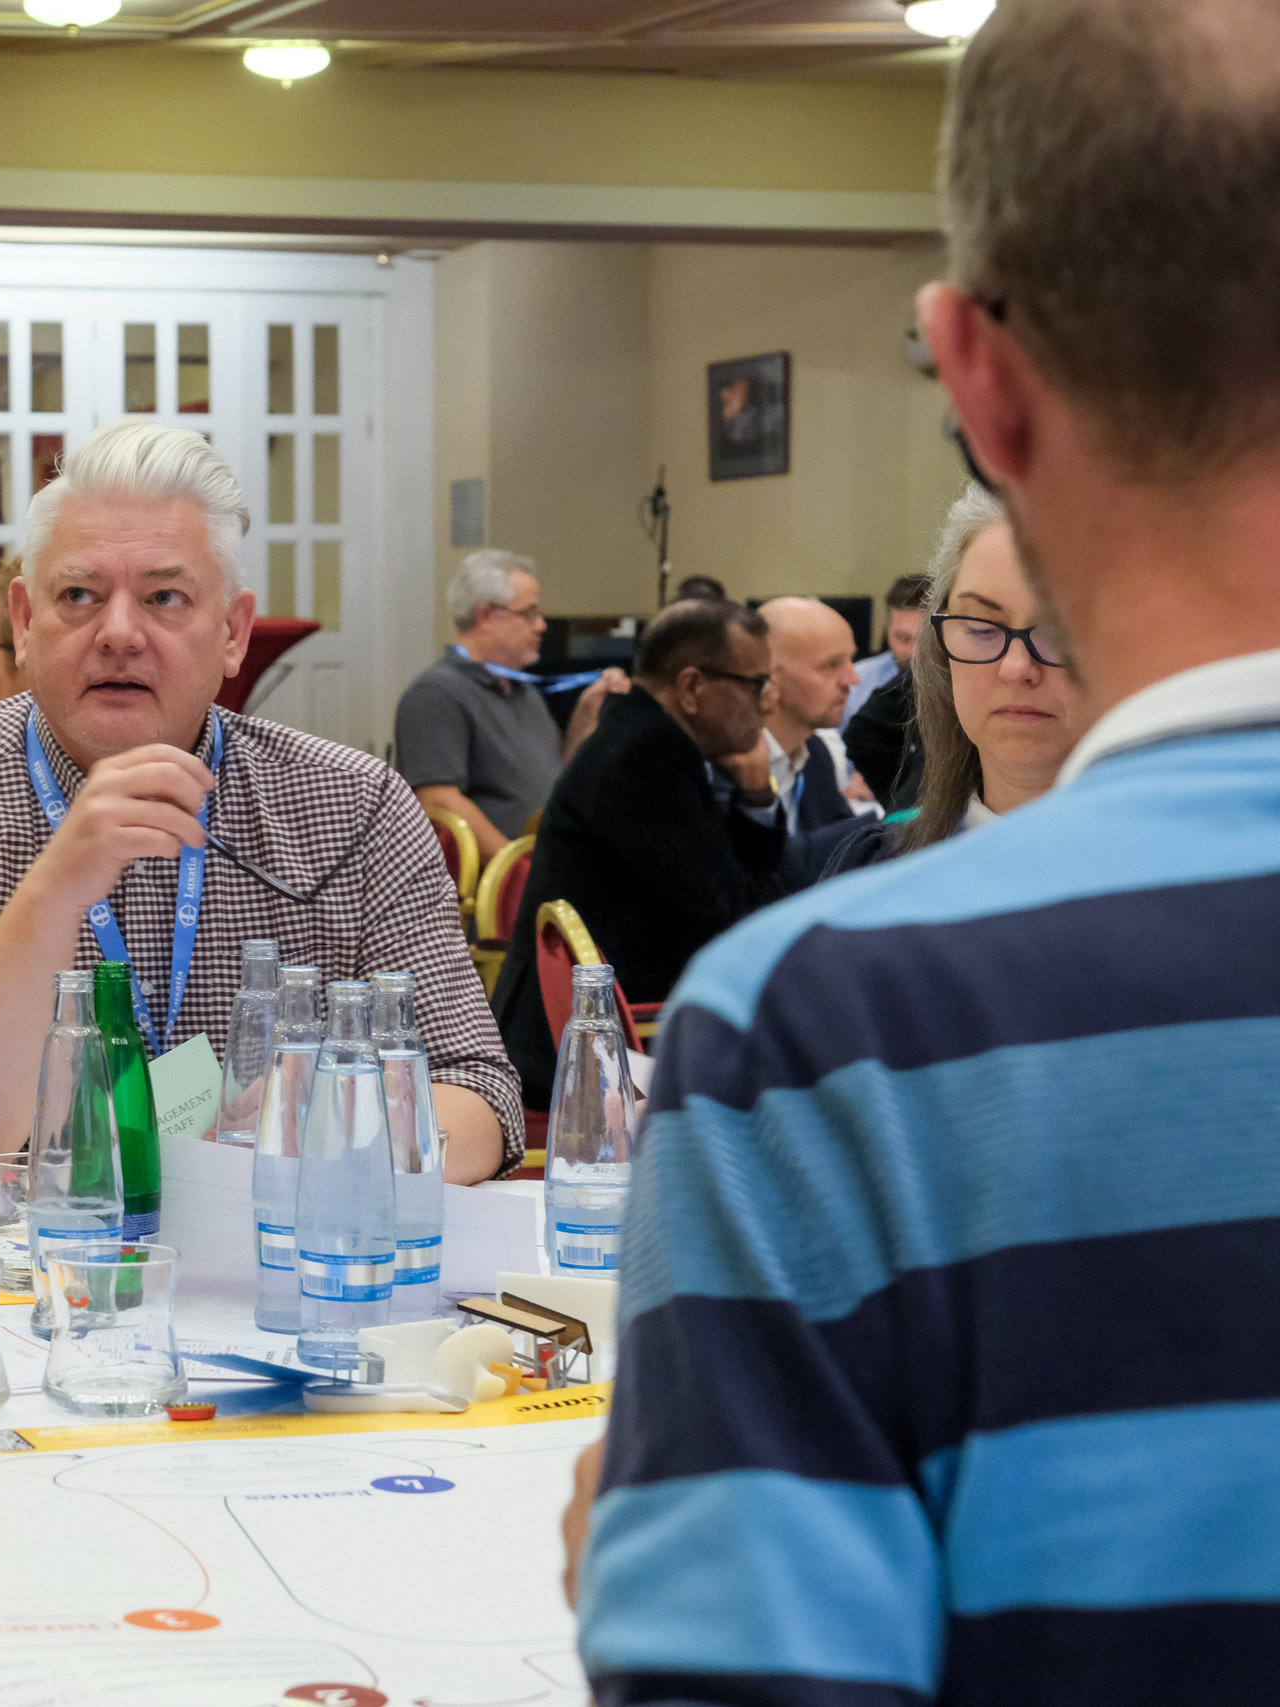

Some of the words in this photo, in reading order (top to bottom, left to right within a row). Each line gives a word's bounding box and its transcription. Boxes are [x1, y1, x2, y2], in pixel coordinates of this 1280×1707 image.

[34, 760, 52, 799] Luxatia
[184, 856, 198, 899] Luxatia
[160, 1114, 195, 1135] TAFF
[514, 1395, 606, 1414] Game
[394, 1478, 424, 1491] 4
